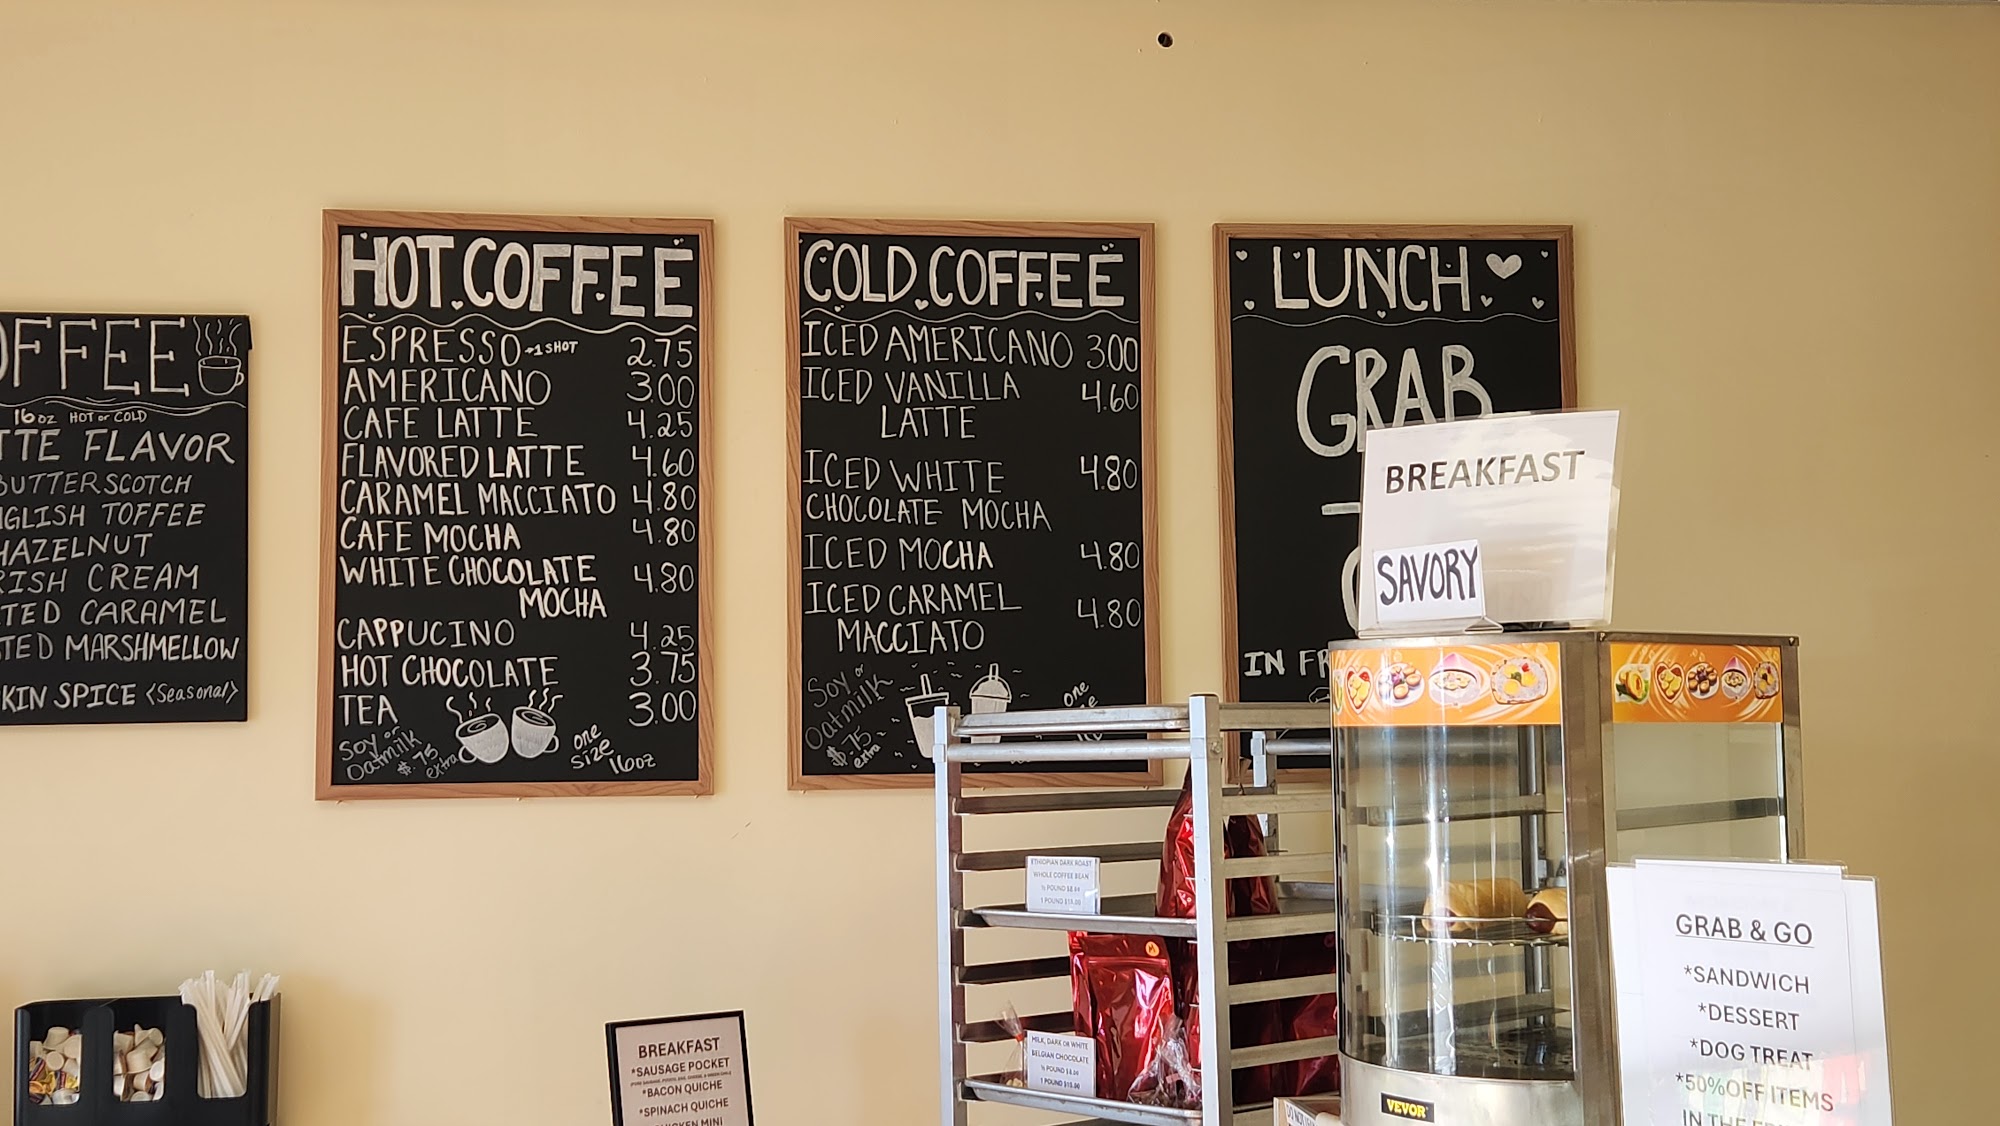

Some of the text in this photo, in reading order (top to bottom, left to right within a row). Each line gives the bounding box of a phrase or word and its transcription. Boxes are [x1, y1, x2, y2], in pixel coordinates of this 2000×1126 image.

[341, 234, 694, 318] HOT COFFEE
[804, 239, 1125, 308] COLD COFFEE
[1272, 244, 1471, 312] LUNCH
[0, 316, 190, 397] FFEE
[343, 325, 521, 366] ESPRESSO
[626, 337, 693, 369] 2.75
[801, 321, 1138, 372] ICED AMERICANO 3.00
[343, 367, 694, 408] AMERICANO 3.00
[802, 367, 1139, 413] ICED VANILLA 4.60
[1297, 344, 1494, 458] GRAB
[70, 412, 94, 424] HOT
[114, 410, 147, 424] COLD
[343, 406, 693, 440] CAFE LATTE 4.25
[881, 405, 976, 438] LATTE
[84, 428, 235, 464] FLAVOR
[342, 443, 694, 479] FLAVORED LATTE 4.60
[803, 450, 1137, 493] ICED WHITE 4.80
[1385, 450, 1585, 495] BREAKFAST
[340, 479, 696, 516] CARAMEL MACCIATO 4.80
[806, 492, 1052, 531] CHOCOLATE MOCHA
[0, 502, 206, 530] GLISH TOFFEE
[339, 516, 695, 554] CAFE MOCHA 4.80
[803, 534, 1139, 571] ICED MOCHA 4.80
[87, 563, 200, 592] CREAM
[339, 554, 694, 594] WHITE CHOCOLATE 4.80
[1377, 545, 1478, 606] SAVORY
[80, 598, 227, 626] CARAMEL
[519, 588, 607, 619] MOCHA
[805, 582, 1141, 629] ICED CARAMEL 4.80
[65, 633, 240, 662] MARSHMELLOW
[337, 618, 694, 651] CAPPUCINO 4.25
[837, 618, 985, 654] MACCIATO
[341, 652, 696, 688] HOT CHOCOLATE 3.75
[1244, 649, 1285, 677] IN
[53, 682, 137, 710] SPICE
[339, 690, 696, 727] TEA 3.00
[1063, 681, 1089, 707] one
[384, 725, 400, 738] or
[574, 724, 602, 750] one
[426, 754, 458, 779] extra
[571, 739, 614, 769] size
[854, 744, 881, 769] extra
[1033, 871, 1052, 879] WHOLE
[1053, 872, 1073, 880] COFFEE
[1060, 859, 1073, 867] DARK
[1045, 897, 1064, 905] POUND
[1675, 913, 1813, 945] GRAB & GO
[638, 1037, 720, 1059] BREAKFAST
[1031, 1049, 1089, 1064] BELGIAN CHOCOLATE
[1047, 1038, 1062, 1047] DARK
[1071, 1041, 1089, 1051] WHITE
[1750, 1046, 1813, 1071] TREAT
[689, 1057, 730, 1071] POCKET
[1046, 1065, 1065, 1074] POUND
[684, 1080, 723, 1095] QUICHE
[1044, 1078, 1063, 1087] POUND
[690, 1098, 729, 1113] QUICHE
[1386, 1098, 1426, 1119] VEVOR
[1771, 1085, 1834, 1112] ITEMS
[701, 1117, 723, 1126] MINI
[1682, 1109, 1702, 1126] IN
